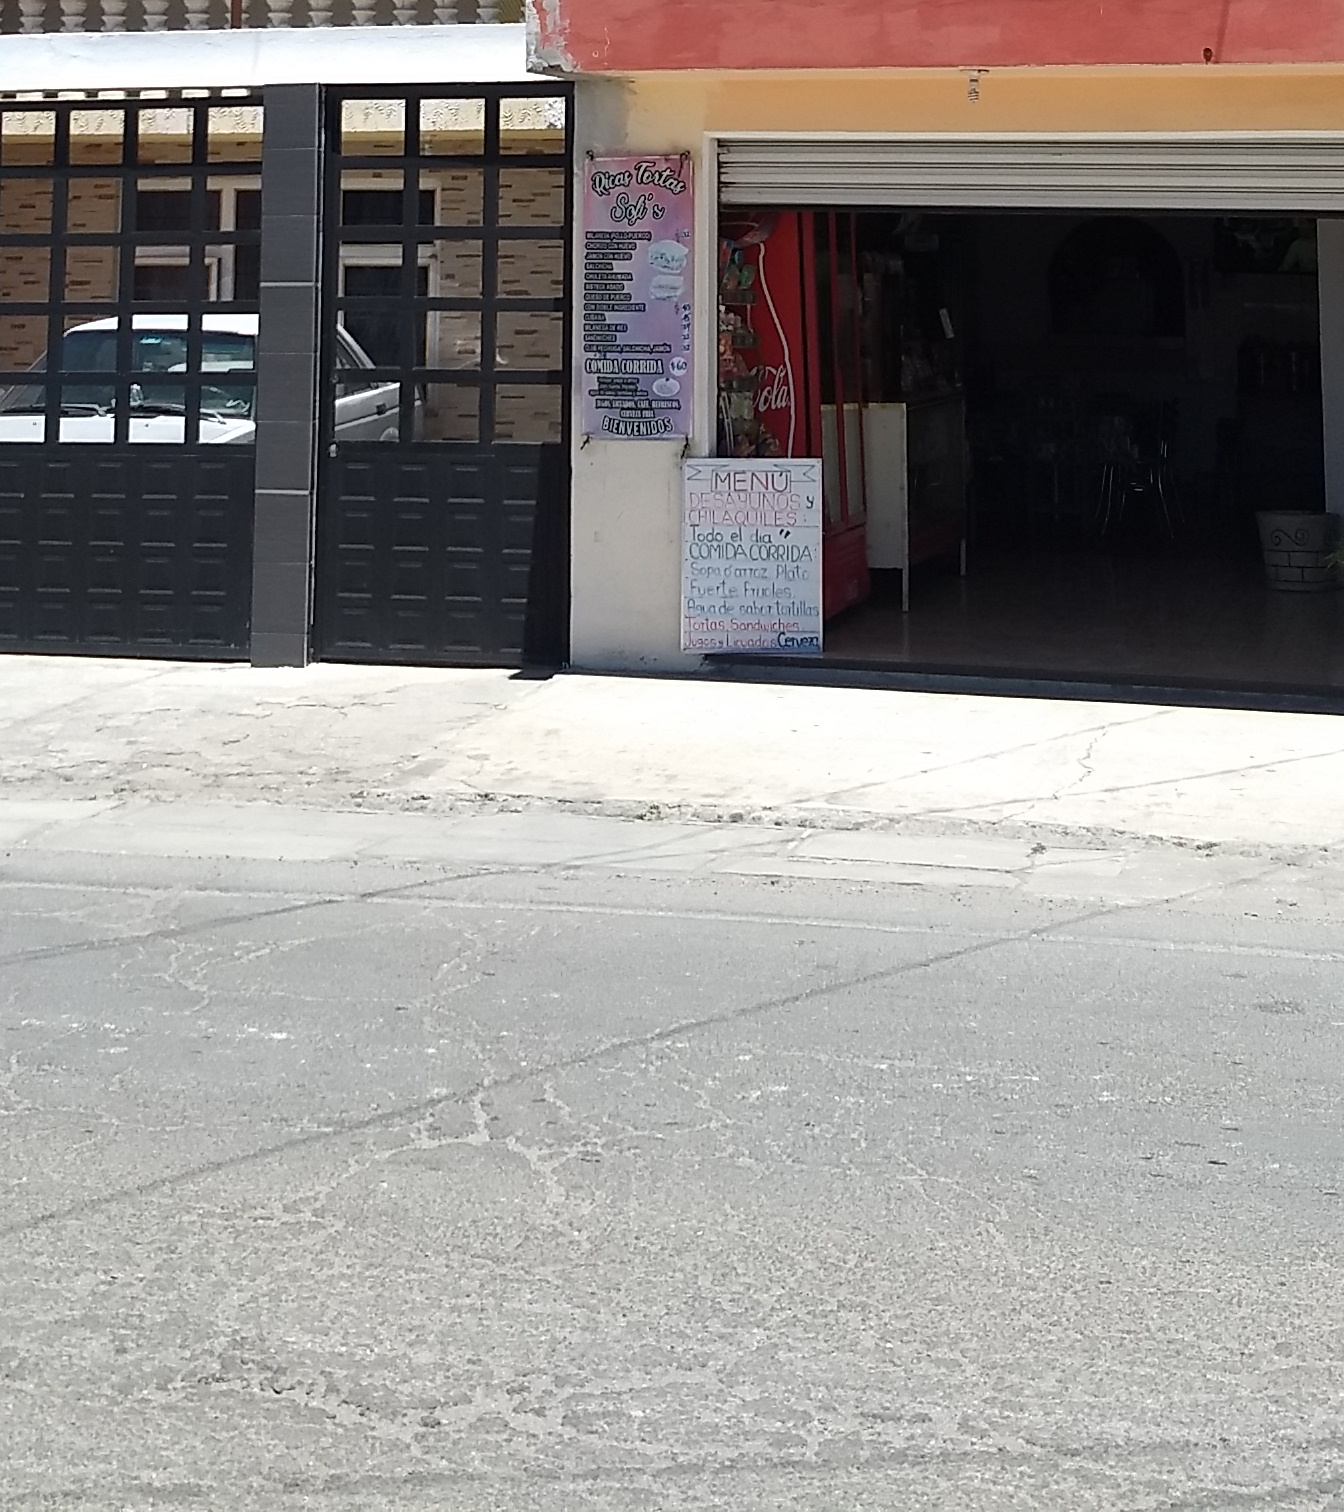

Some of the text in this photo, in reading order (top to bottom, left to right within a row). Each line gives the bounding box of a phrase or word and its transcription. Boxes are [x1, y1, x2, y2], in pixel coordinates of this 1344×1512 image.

[592, 161, 686, 196] Ricas Tortas
[586, 359, 664, 373] COMIDA CORRIDA
[602, 415, 673, 436] BIENVENIDOS
[715, 471, 788, 492] MENÚ
[690, 492, 800, 511] DESAYUNOS
[690, 524, 724, 542] Todo
[730, 526, 742, 542] el
[689, 542, 748, 559] COMIDA
[690, 562, 720, 578] Sopa
[735, 567, 768, 579] arroz
[776, 564, 810, 581] Plato
[690, 579, 738, 597] Fuerte
[687, 598, 820, 617] Agua de sabor tortillas
[685, 630, 716, 648] Jugos
[777, 631, 819, 648] Cerveza
